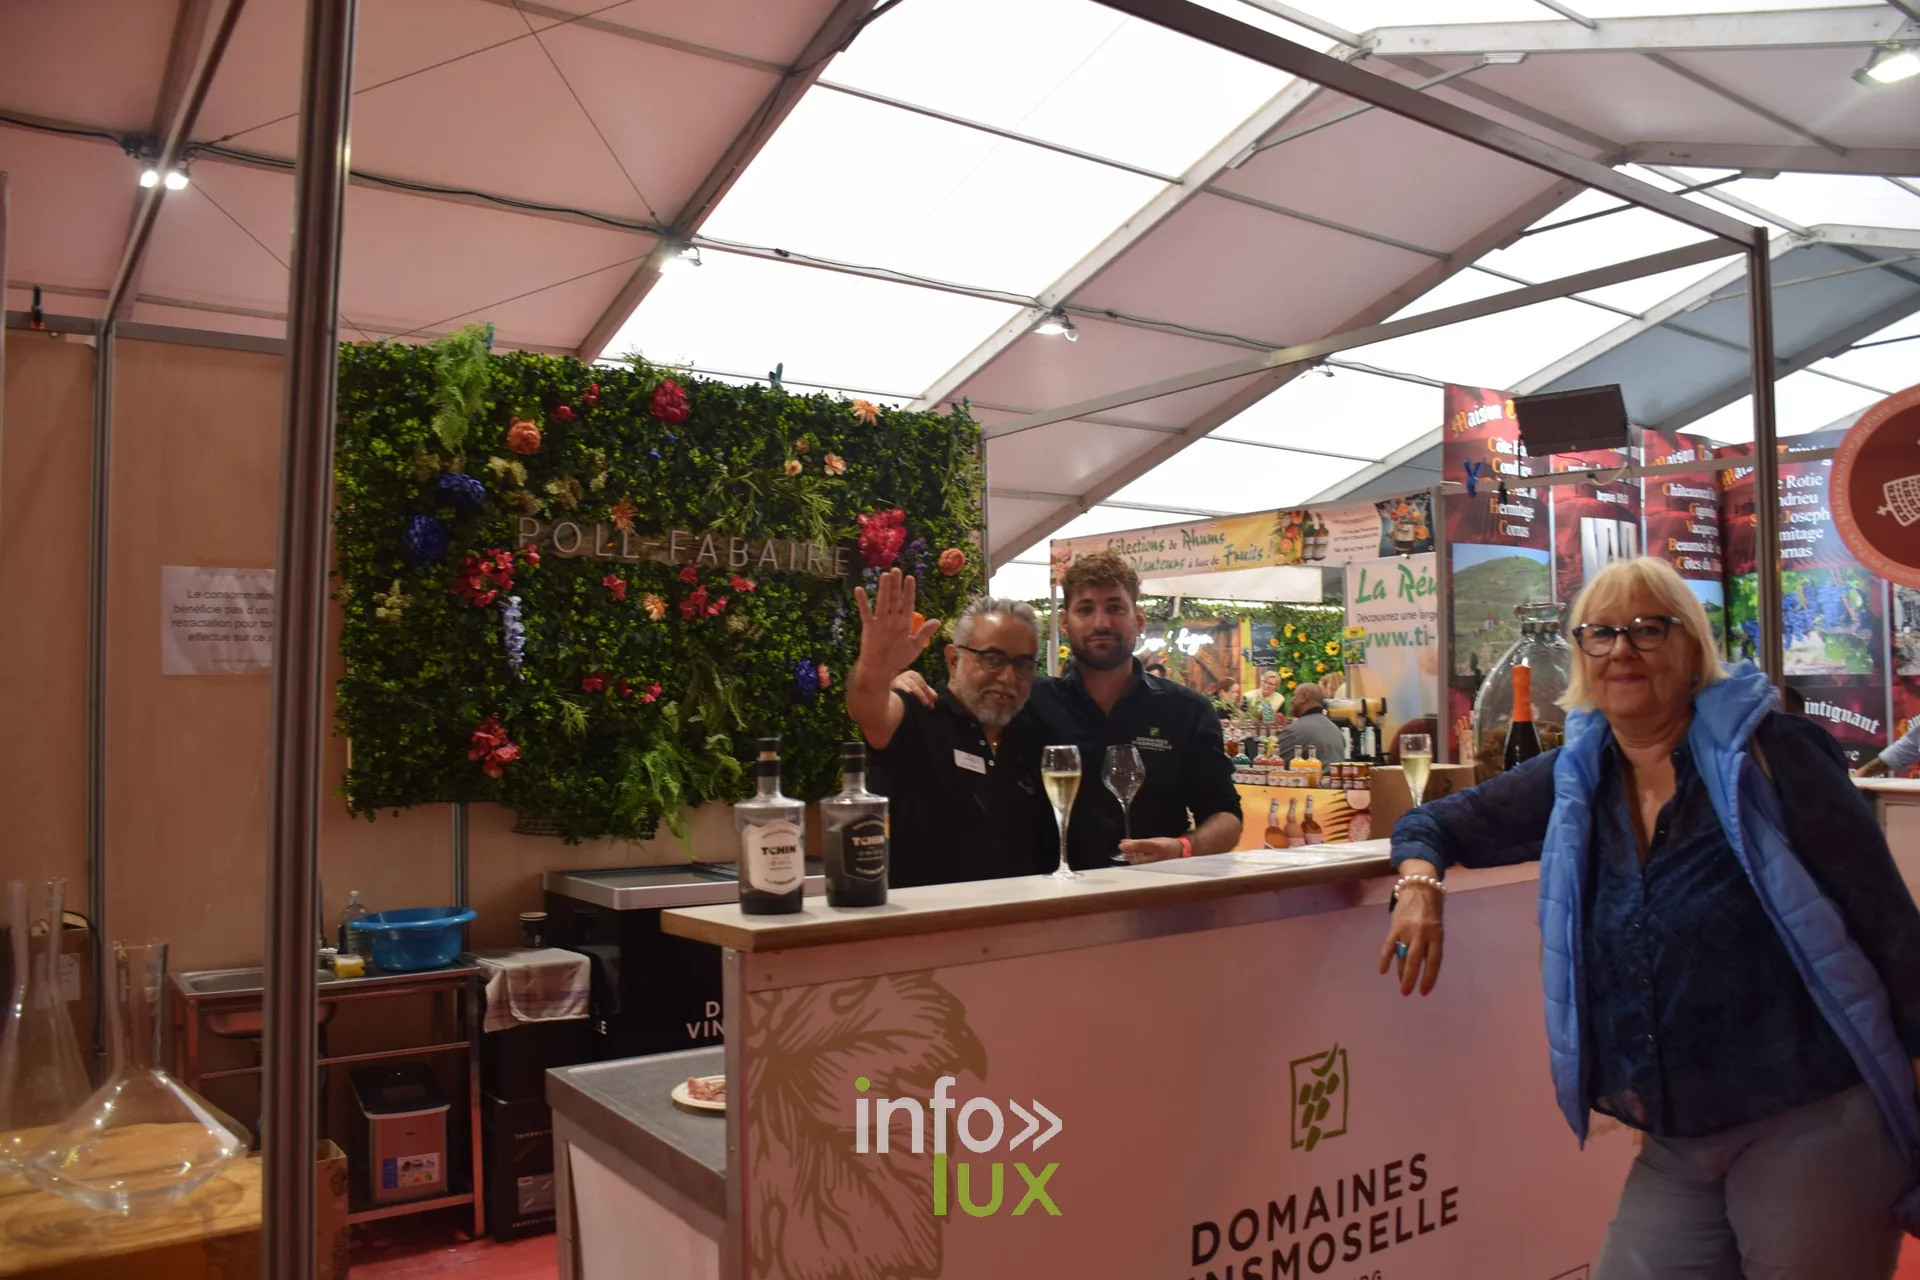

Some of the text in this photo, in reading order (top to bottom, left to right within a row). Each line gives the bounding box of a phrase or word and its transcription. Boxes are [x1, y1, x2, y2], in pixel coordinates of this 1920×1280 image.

[518, 517, 850, 577] POLL-FABAIRE
[1355, 568, 1386, 604] La
[187, 590, 201, 599] Le
[224, 606, 243, 615] pas
[234, 620, 258, 629] pour
[232, 633, 250, 641] sur
[1191, 1152, 1428, 1267] DOMAINES
